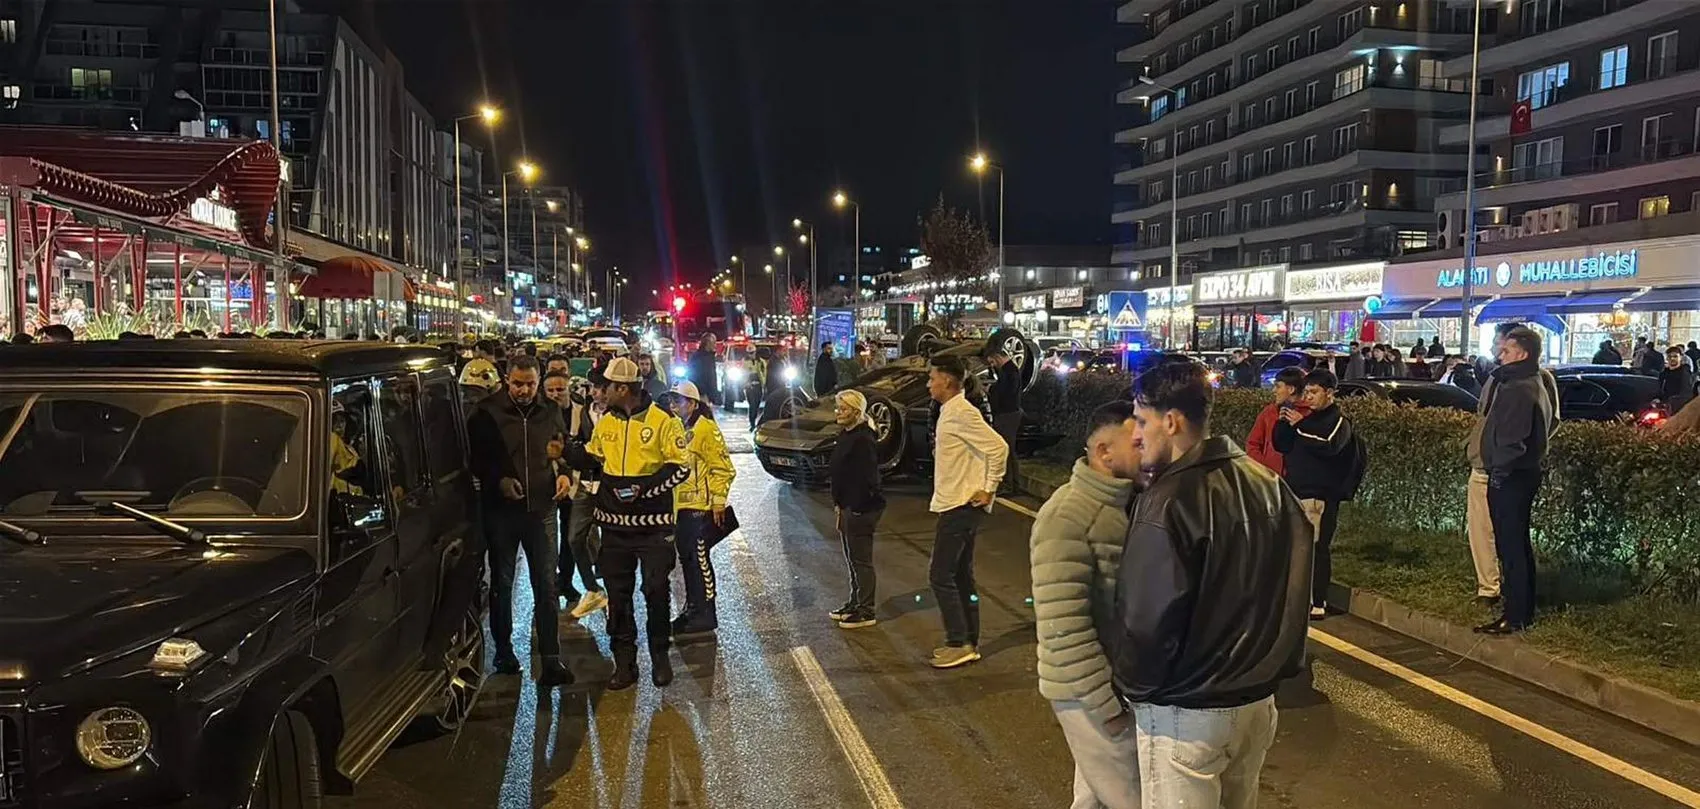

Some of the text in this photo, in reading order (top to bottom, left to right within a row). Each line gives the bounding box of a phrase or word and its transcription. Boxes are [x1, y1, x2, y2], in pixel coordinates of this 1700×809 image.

[1437, 249, 1637, 287] ALAATI MUHALLEBİCİSİ
[1200, 275, 1229, 300] EXPO
[1229, 273, 1246, 298] 34
